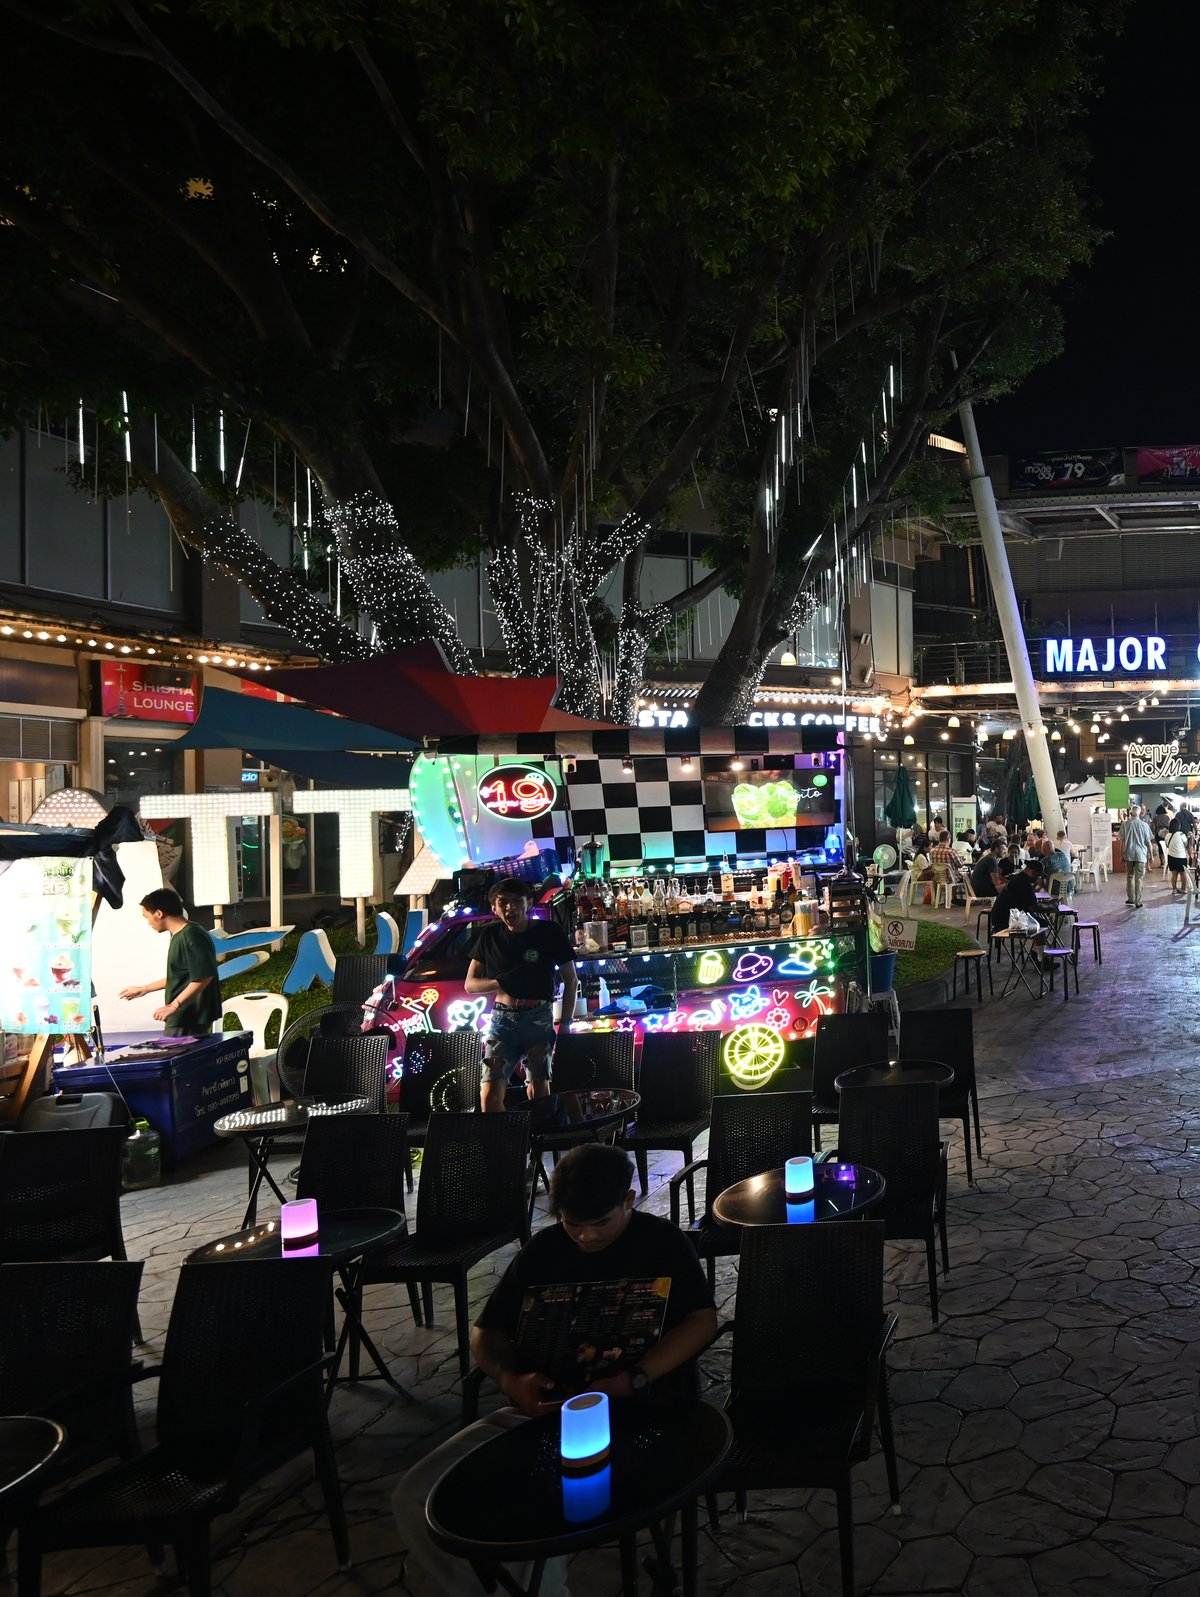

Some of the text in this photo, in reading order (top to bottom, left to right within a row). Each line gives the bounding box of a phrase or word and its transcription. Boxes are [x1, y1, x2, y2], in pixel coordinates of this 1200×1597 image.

[1063, 462, 1086, 480] 79
[1046, 637, 1166, 672] MAJOR
[132, 680, 195, 697] SHISHA
[133, 697, 195, 713] LOUNGE
[1128, 742, 1180, 756] Avenue
